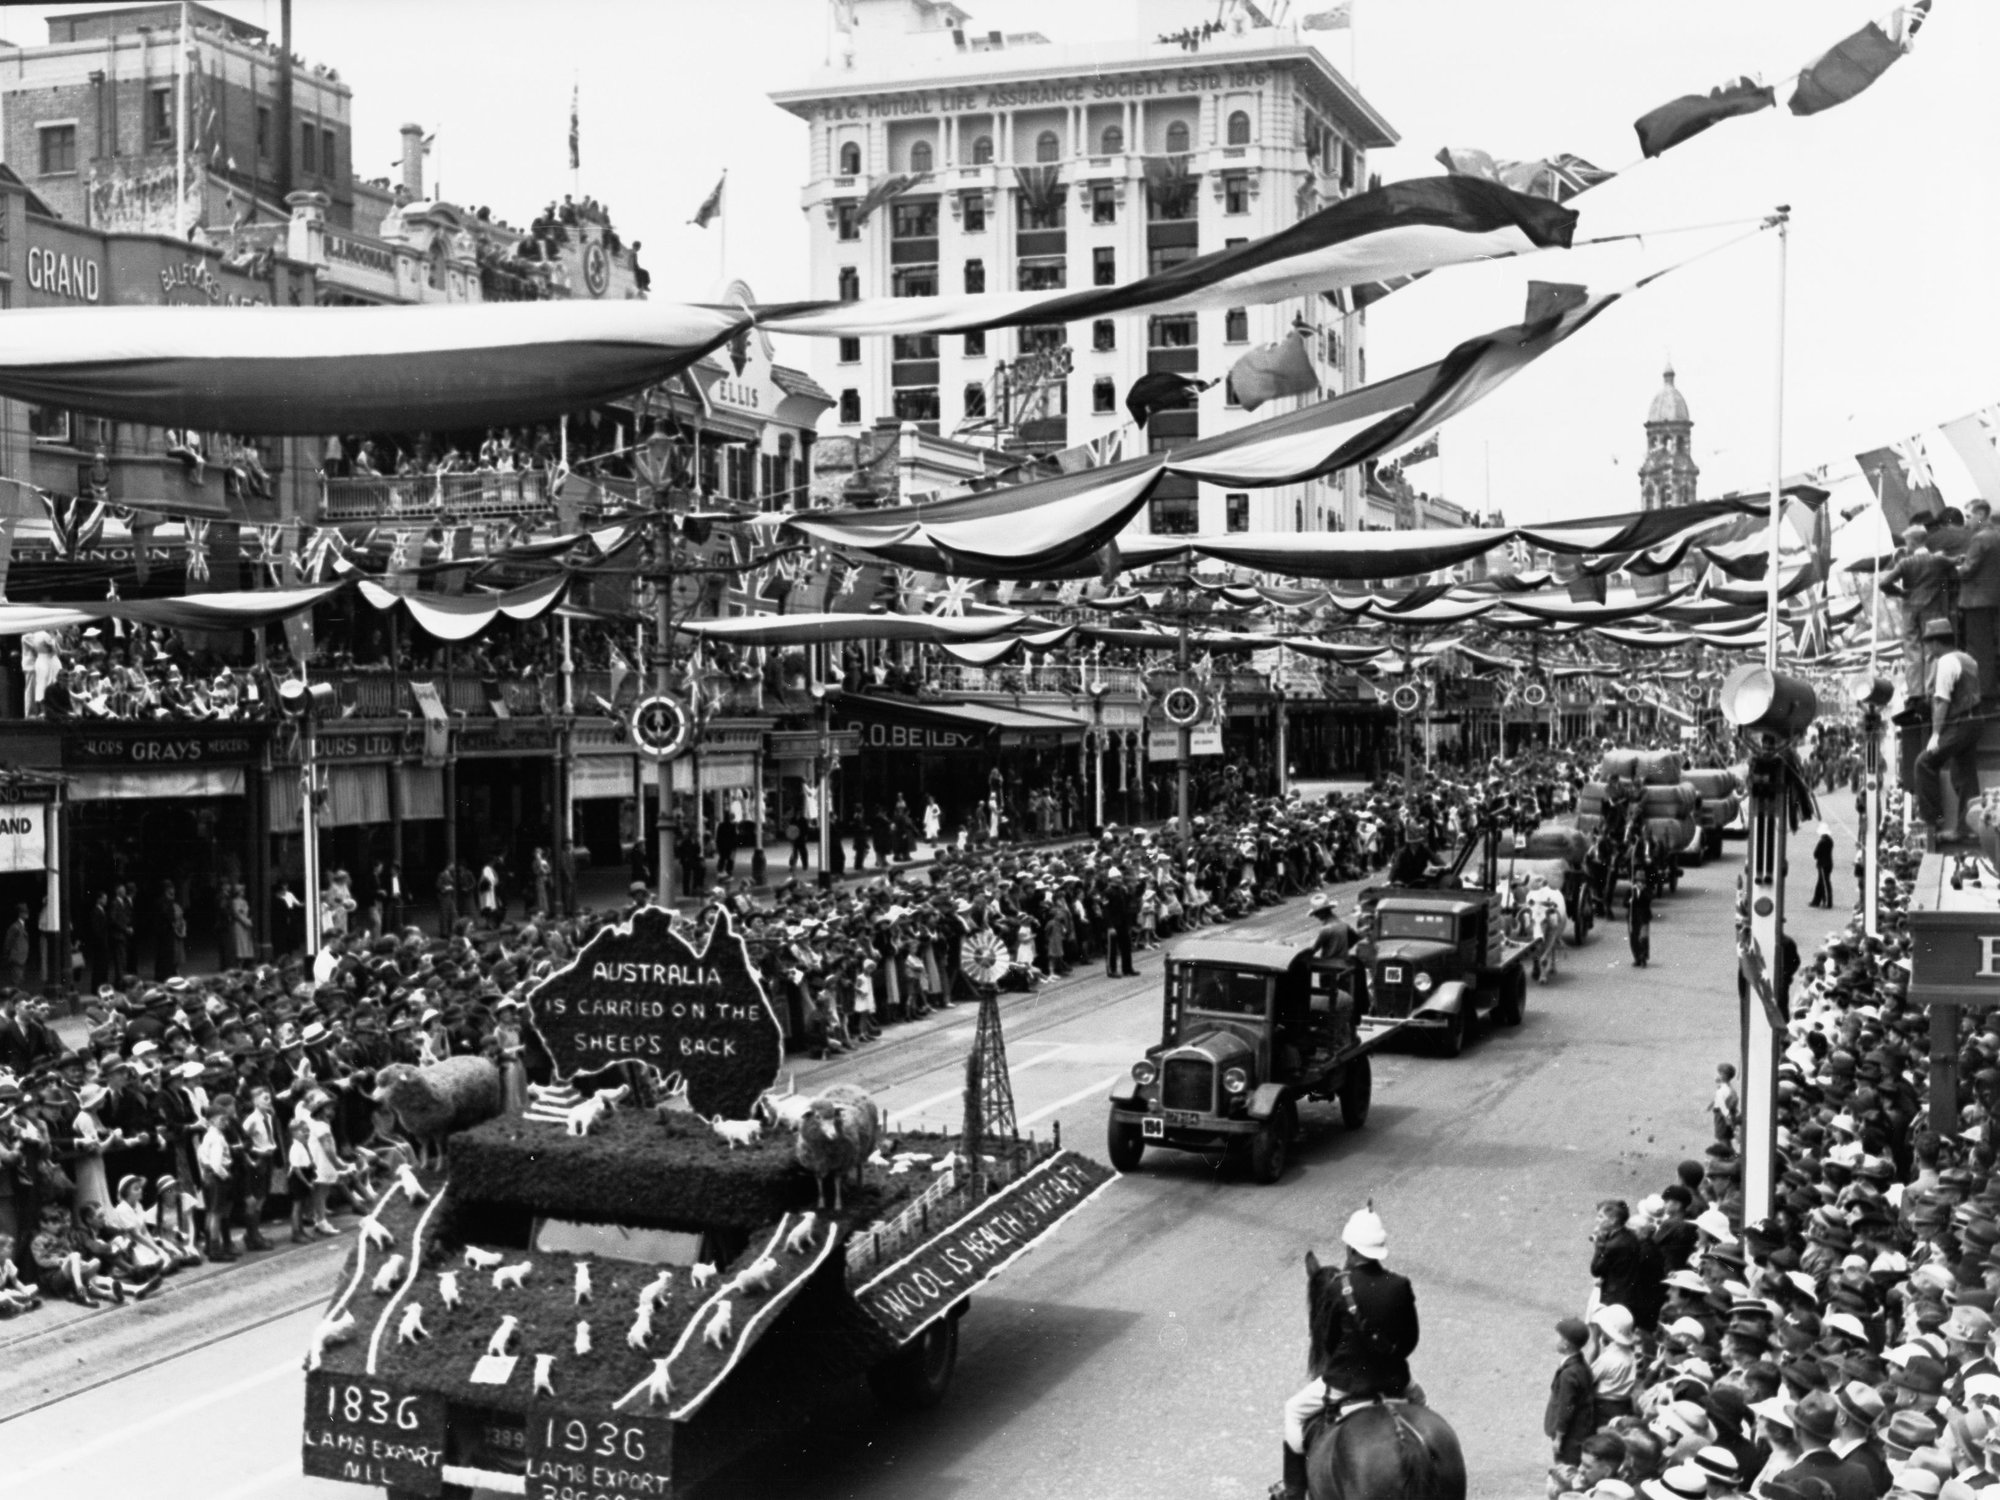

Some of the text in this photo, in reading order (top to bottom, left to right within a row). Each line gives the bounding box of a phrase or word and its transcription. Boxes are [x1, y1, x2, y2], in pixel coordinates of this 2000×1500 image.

[867, 97, 932, 117] MUTUAL
[940, 94, 976, 112] LIFE
[987, 84, 1083, 107] ASSURANCE
[28, 247, 98, 300] GRAND
[720, 379, 758, 409] ELLIS
[131, 741, 202, 760] GRAYS
[592, 962, 721, 985] AUSTRALIA
[546, 999, 761, 1021] IS CARRIED ON THE
[680, 1037, 736, 1056] BACK
[874, 1267, 954, 1321] WOOL
[939, 1247, 972, 1275] IS
[961, 1210, 1026, 1261] HEALTH
[1024, 1162, 1091, 1214] WEALTH
[328, 1385, 418, 1429] 1836
[305, 1429, 443, 1468] LAMB EXPORT
[547, 1418, 645, 1461] 1936
[344, 1462, 394, 1485] NIL
[526, 1458, 587, 1483] LAMB
[593, 1466, 670, 1493] EXPORT
